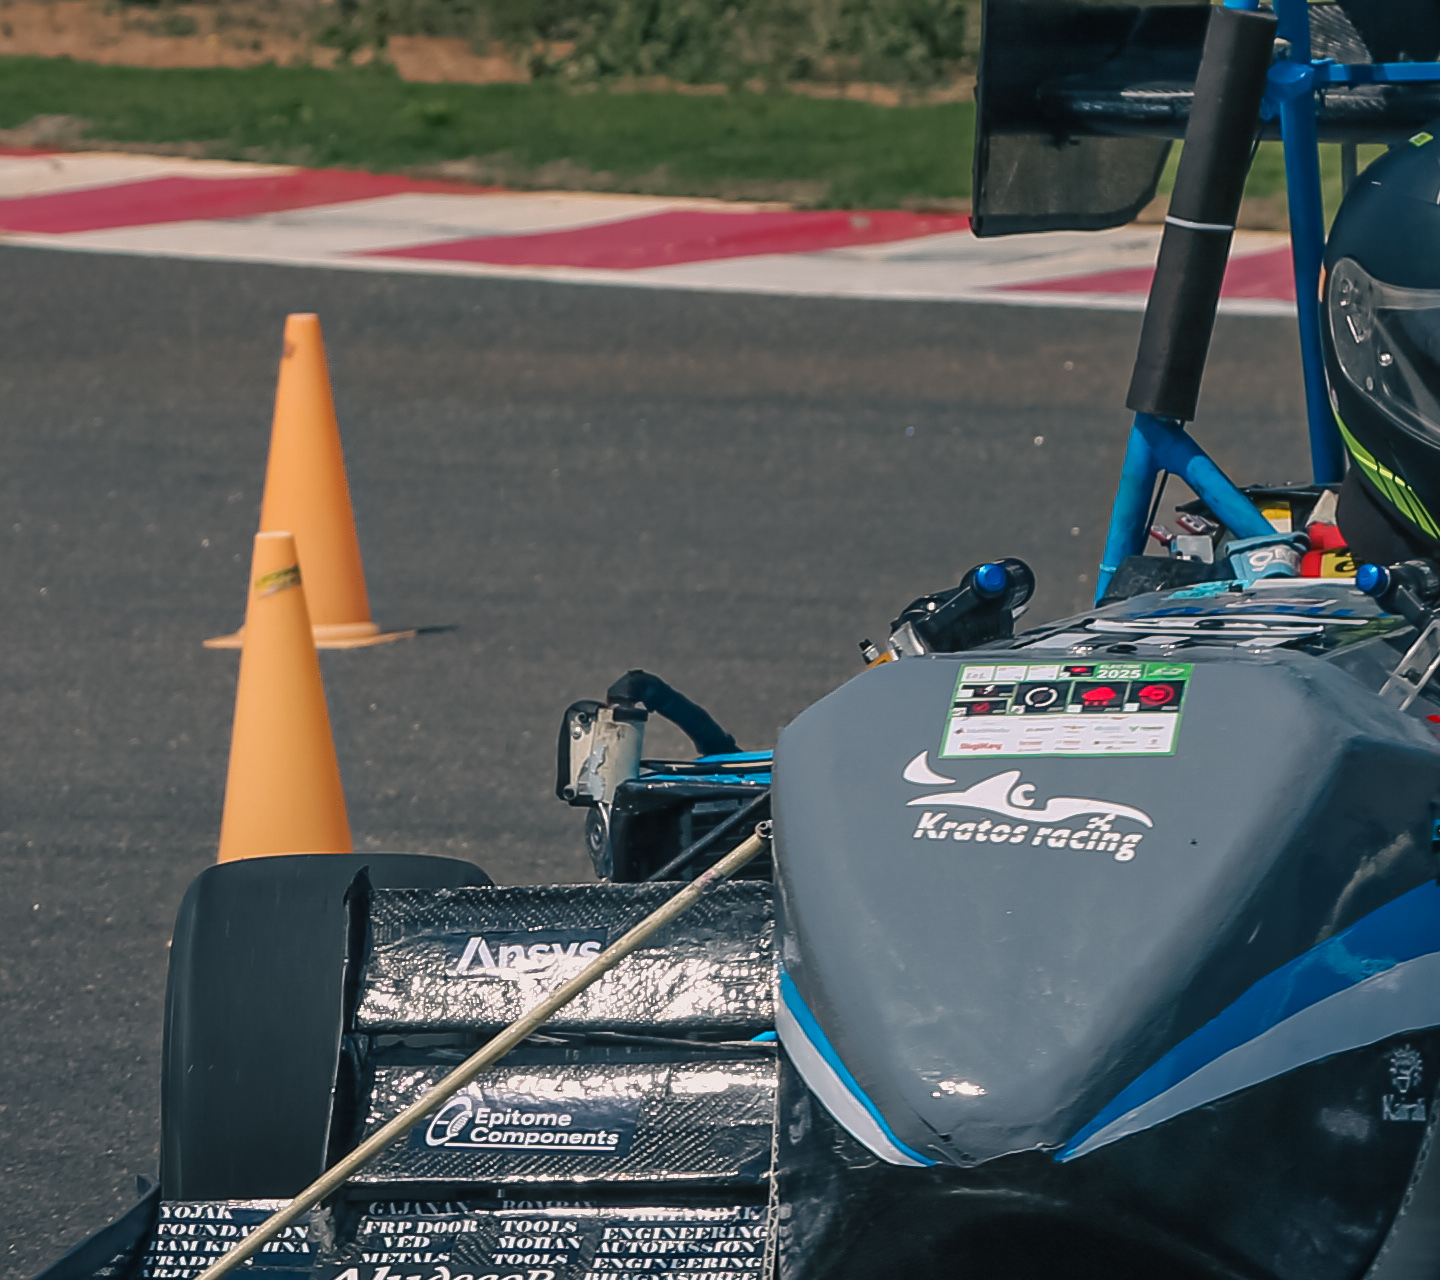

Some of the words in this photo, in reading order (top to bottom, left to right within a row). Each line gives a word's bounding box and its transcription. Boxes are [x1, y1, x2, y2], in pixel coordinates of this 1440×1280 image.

[1096, 669, 1142, 679] 2025
[913, 812, 1029, 844] Kratos
[1031, 814, 1143, 862] racing
[475, 1107, 573, 1128] Epitome
[470, 1127, 619, 1146] Components
[161, 1205, 233, 1220] YOJAK
[364, 1221, 412, 1235] FRP
[501, 1220, 578, 1234] TOOLS
[603, 1226, 769, 1240] ENGINEERING
[149, 1240, 198, 1253] RAM
[383, 1236, 431, 1249] VED
[360, 1252, 452, 1264] METALS
[491, 1254, 569, 1266] TOOLS
[592, 1258, 762, 1270] ENGINEERING
